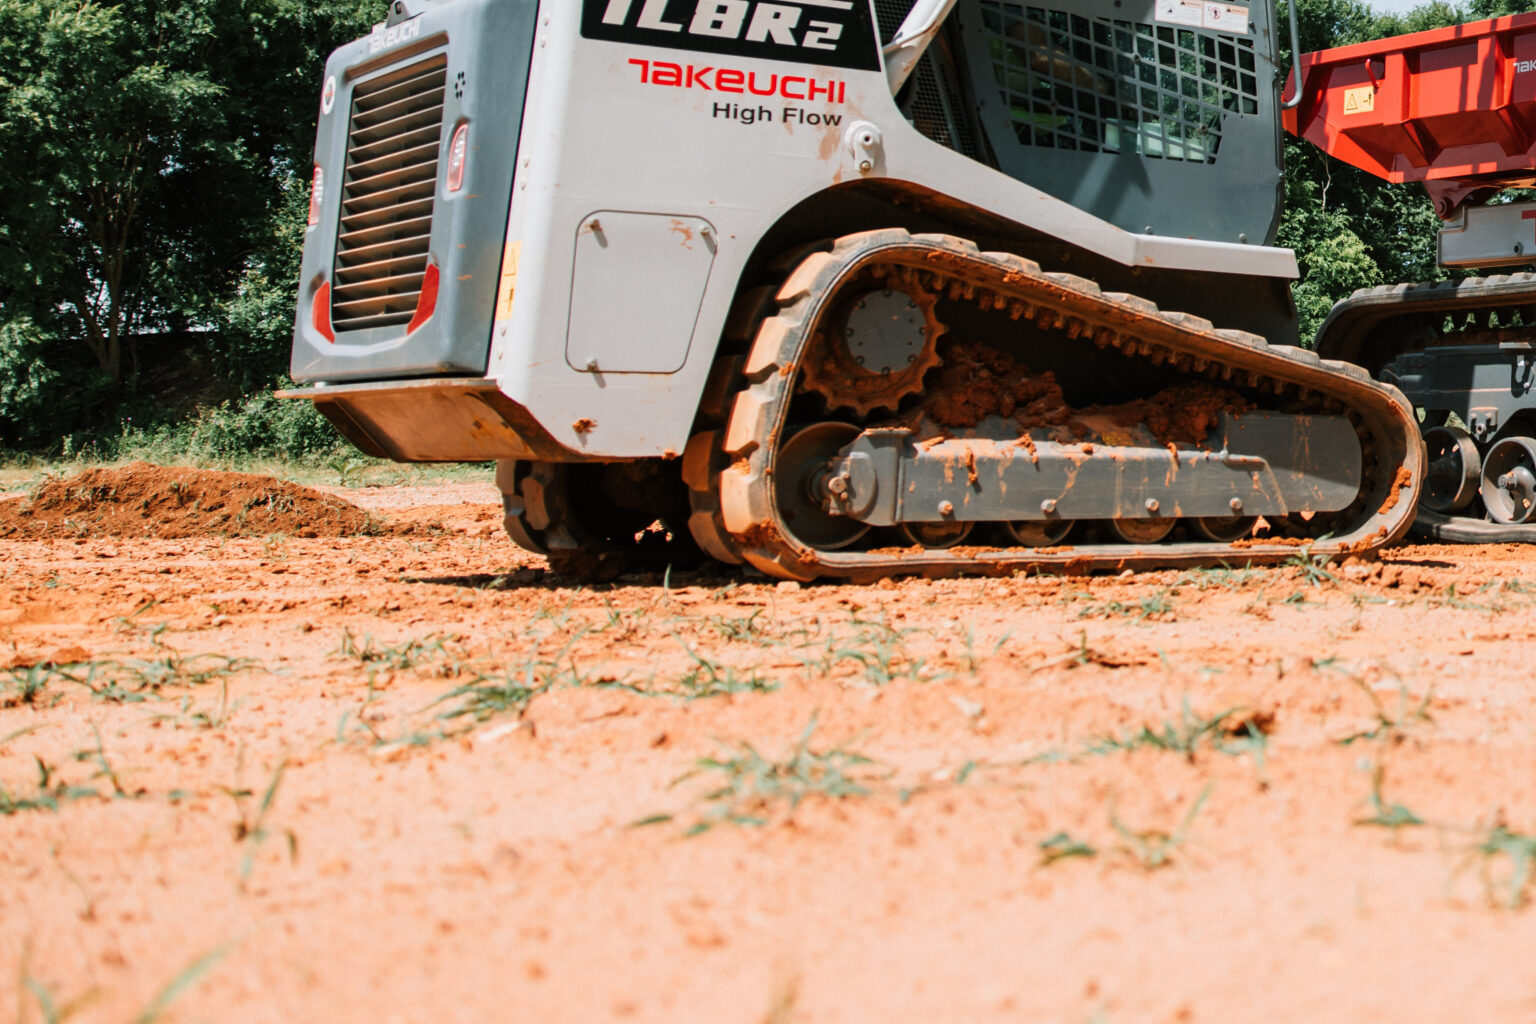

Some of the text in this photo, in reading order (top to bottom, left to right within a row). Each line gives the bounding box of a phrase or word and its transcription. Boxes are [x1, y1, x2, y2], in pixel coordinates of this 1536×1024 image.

[628, 58, 846, 104] TAKEUCHI
[712, 102, 842, 127] High Flow
